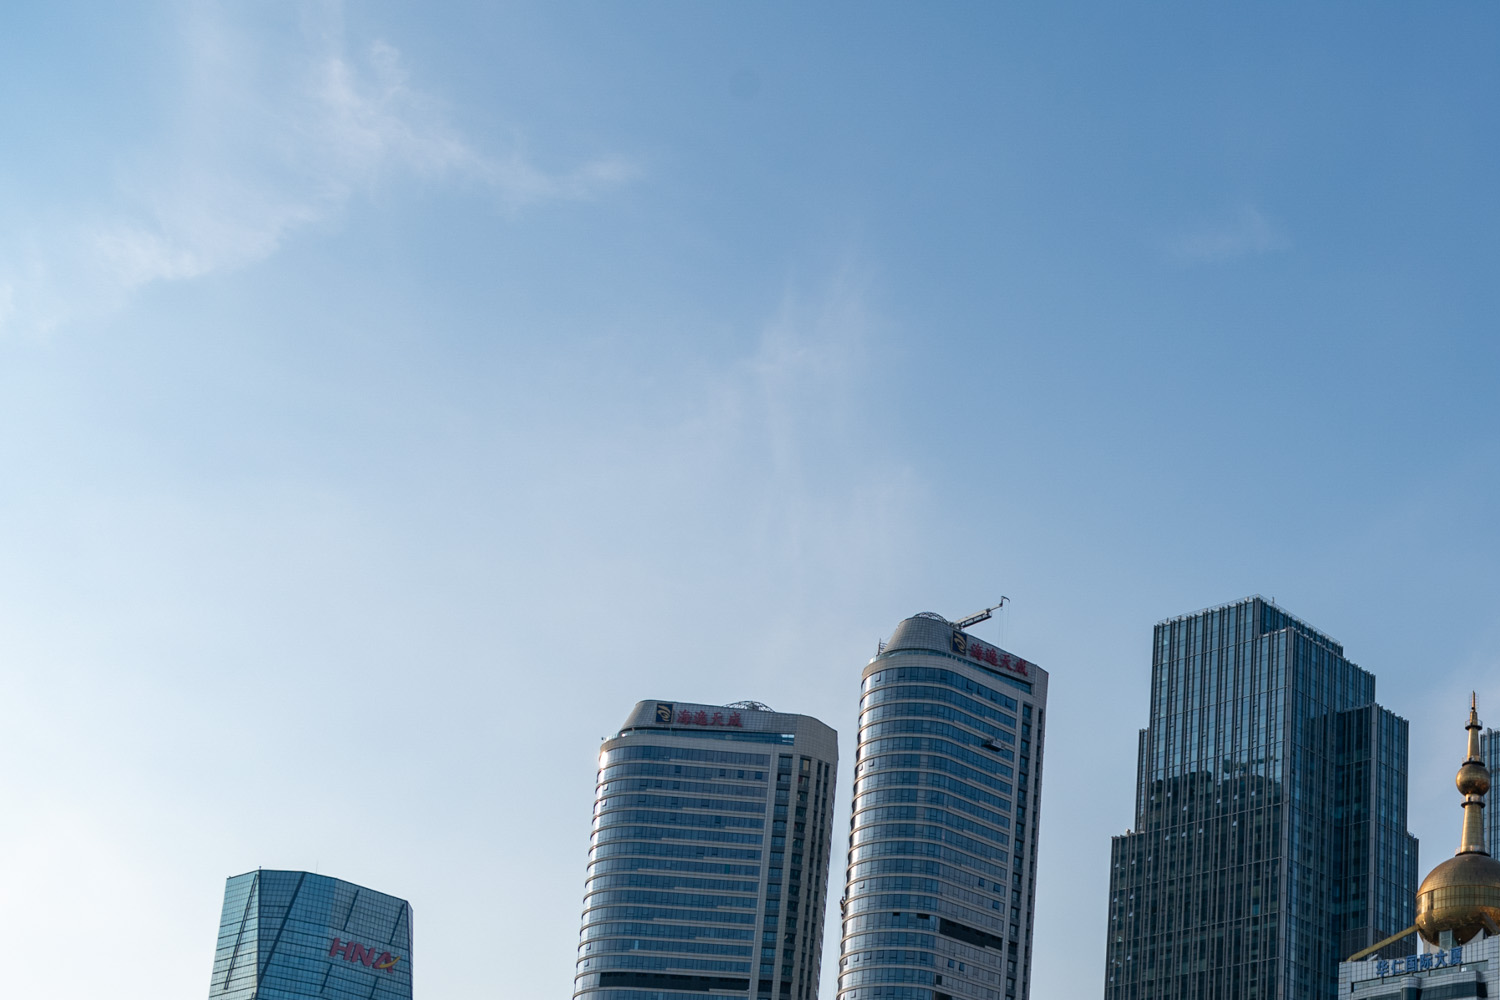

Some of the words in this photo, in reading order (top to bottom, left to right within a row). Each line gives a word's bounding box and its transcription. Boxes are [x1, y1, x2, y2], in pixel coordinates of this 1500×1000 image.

[676, 709, 742, 727] 海逸天成
[329, 937, 401, 973] HNA
[1376, 946, 1464, 978] 华仁国际大厦
